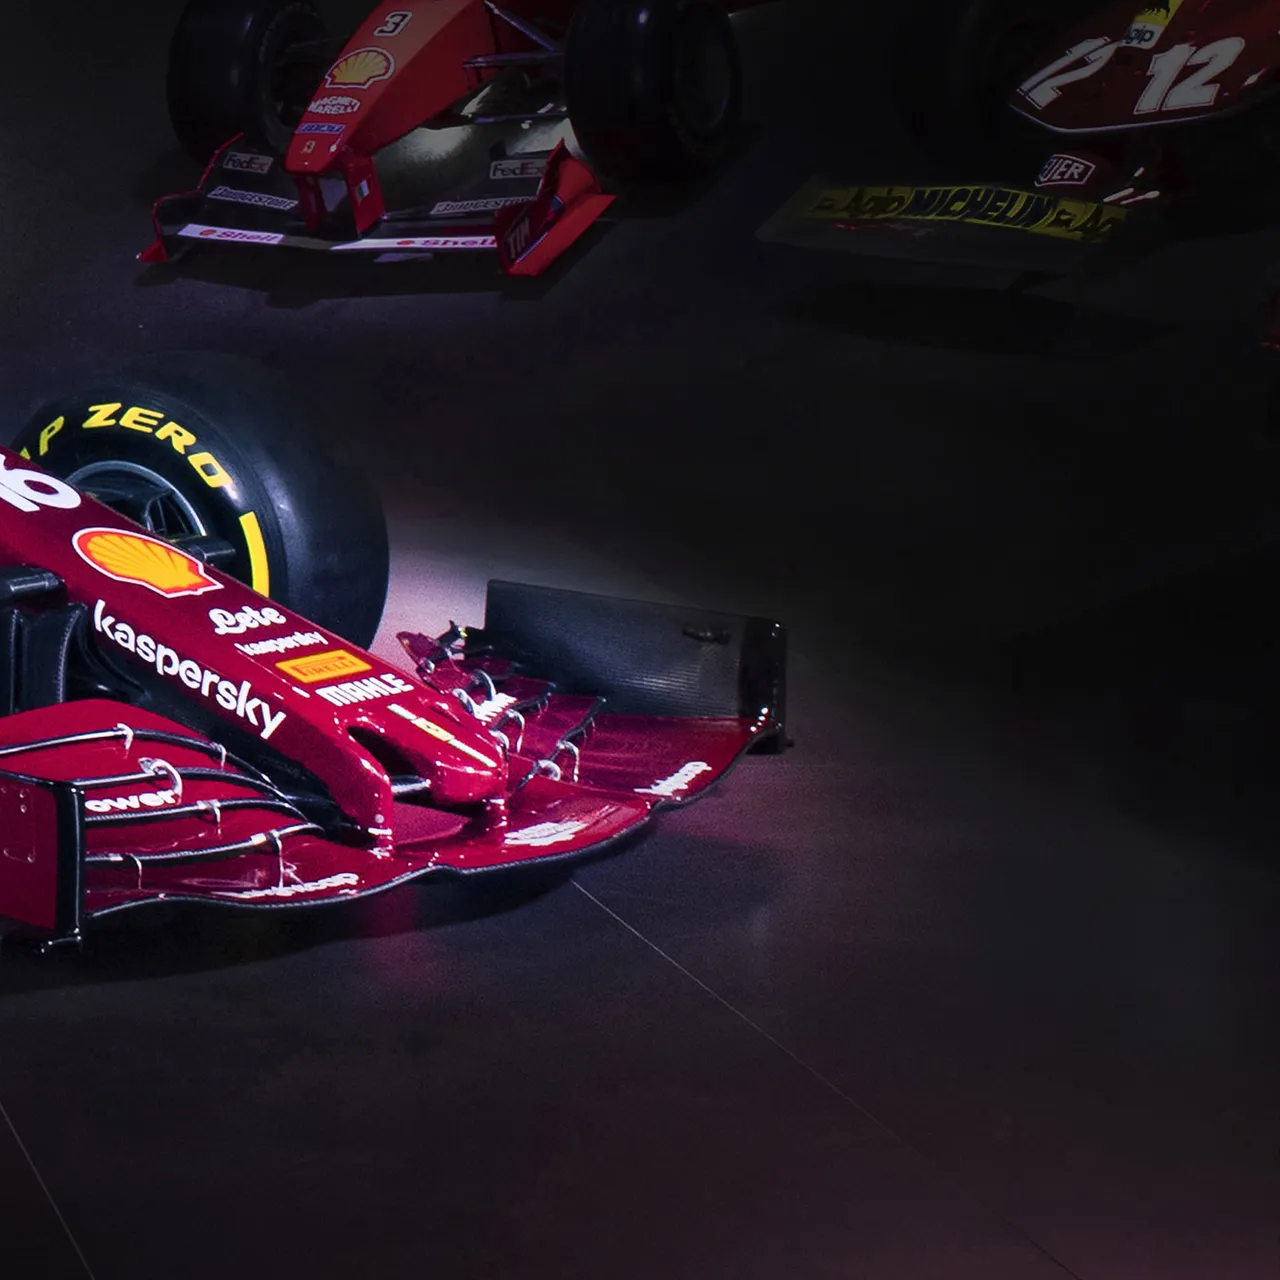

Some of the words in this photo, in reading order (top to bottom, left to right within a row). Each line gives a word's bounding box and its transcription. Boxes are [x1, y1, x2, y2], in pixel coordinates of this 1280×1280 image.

[375, 12, 412, 36] 3
[1133, 37, 1245, 115] 12
[39, 415, 65, 456] P
[81, 402, 234, 488] ZERO
[94, 598, 287, 740] kaspersky
[314, 672, 415, 707] MAHLE
[84, 788, 176, 813] ower
